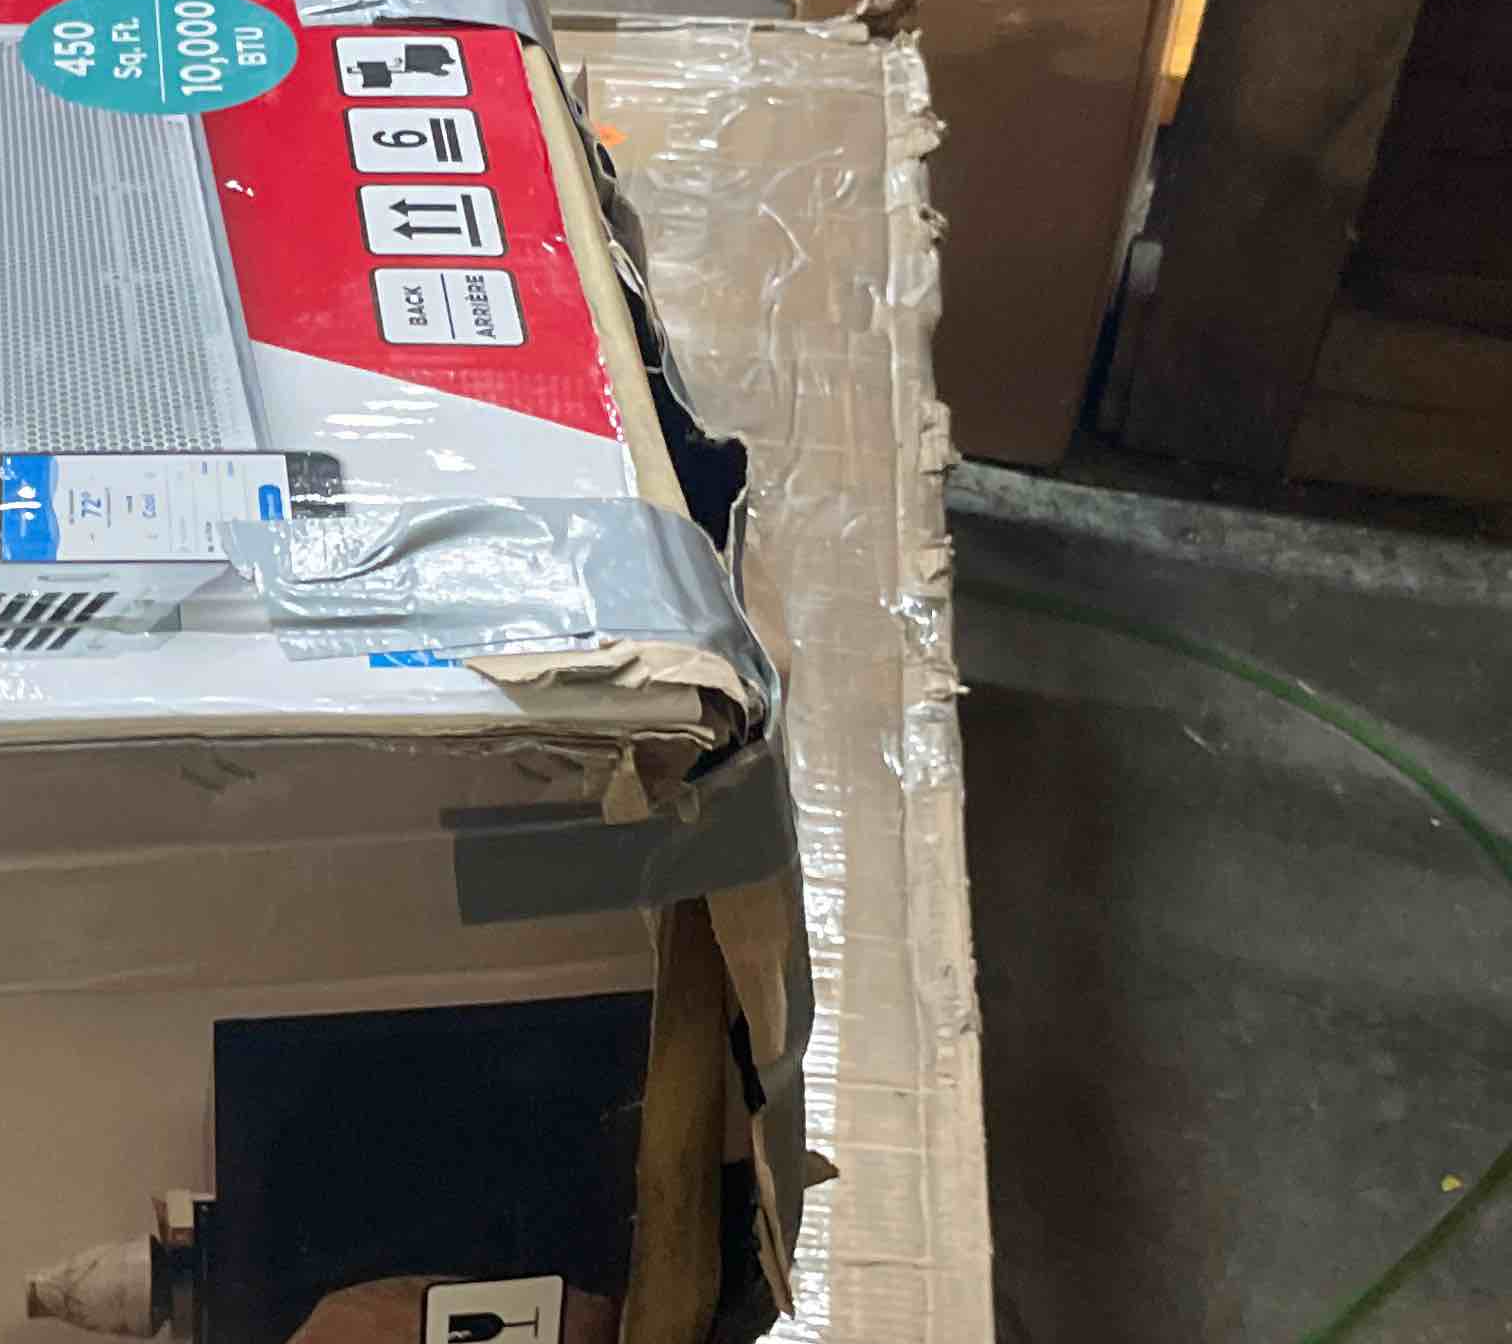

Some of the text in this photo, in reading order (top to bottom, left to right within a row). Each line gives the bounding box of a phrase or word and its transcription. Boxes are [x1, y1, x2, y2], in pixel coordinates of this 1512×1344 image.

[52, 20, 96, 77] 450
[173, 0, 229, 97] 10,000
[233, 26, 267, 67] BTU
[372, 129, 428, 149] 6
[405, 285, 428, 328] BACK
